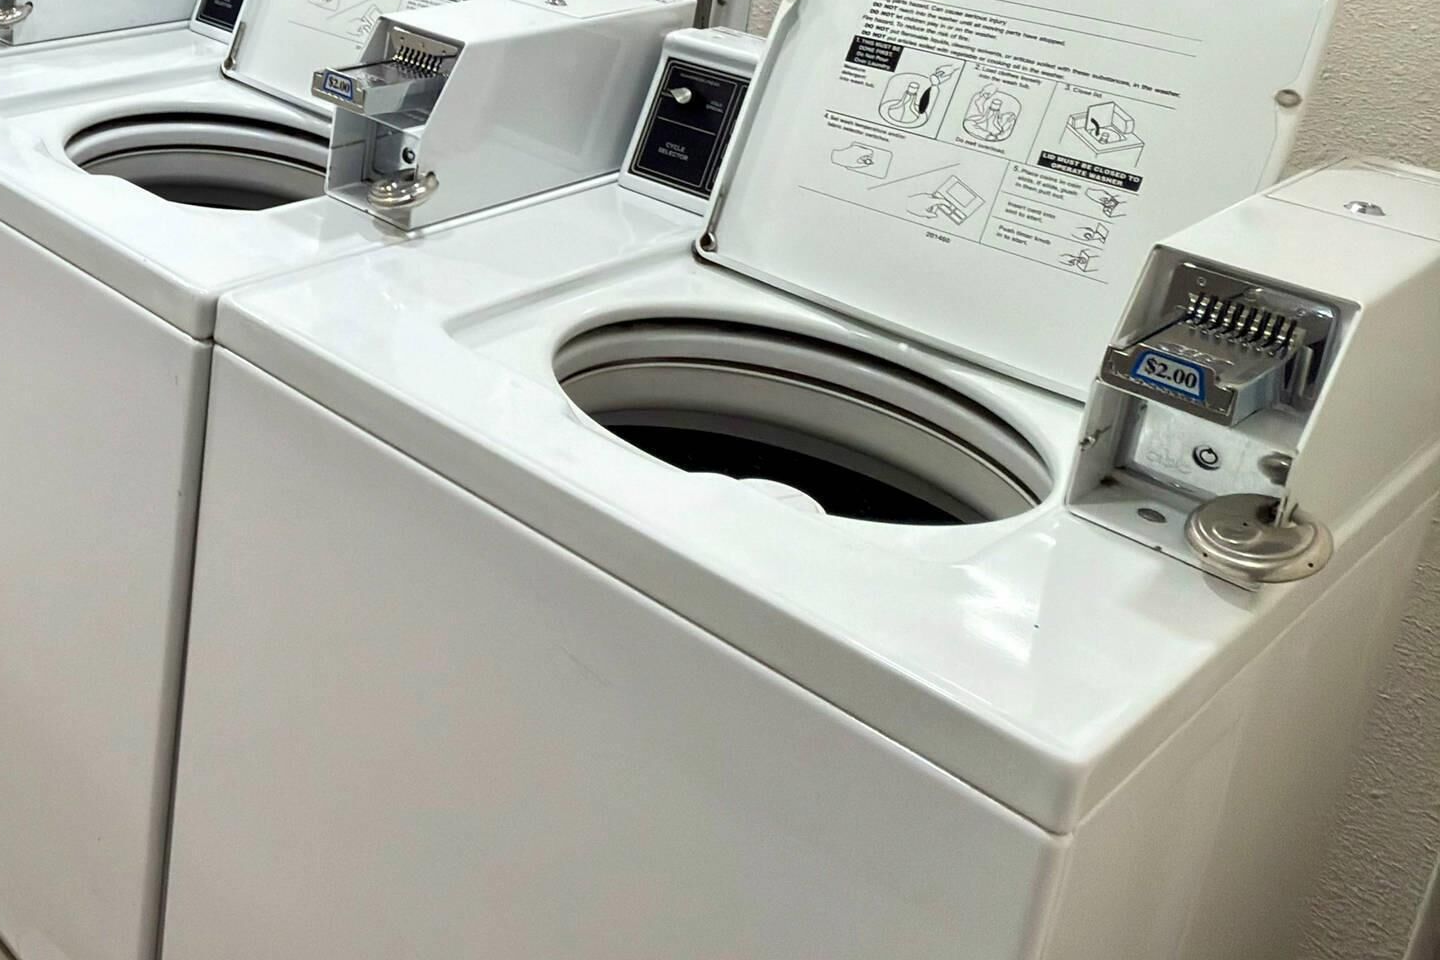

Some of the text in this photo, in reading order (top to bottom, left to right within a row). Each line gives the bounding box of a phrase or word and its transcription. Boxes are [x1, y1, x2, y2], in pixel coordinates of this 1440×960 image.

[328, 76, 350, 93] $2.00
[657, 147, 688, 160] SELECTOR
[665, 142, 686, 152] CYCLE
[1050, 163, 1123, 186] OPERATE WASHER
[1057, 157, 1079, 166] MUST
[1093, 166, 1126, 179] CLOSED
[1145, 357, 1198, 388] $2.00
